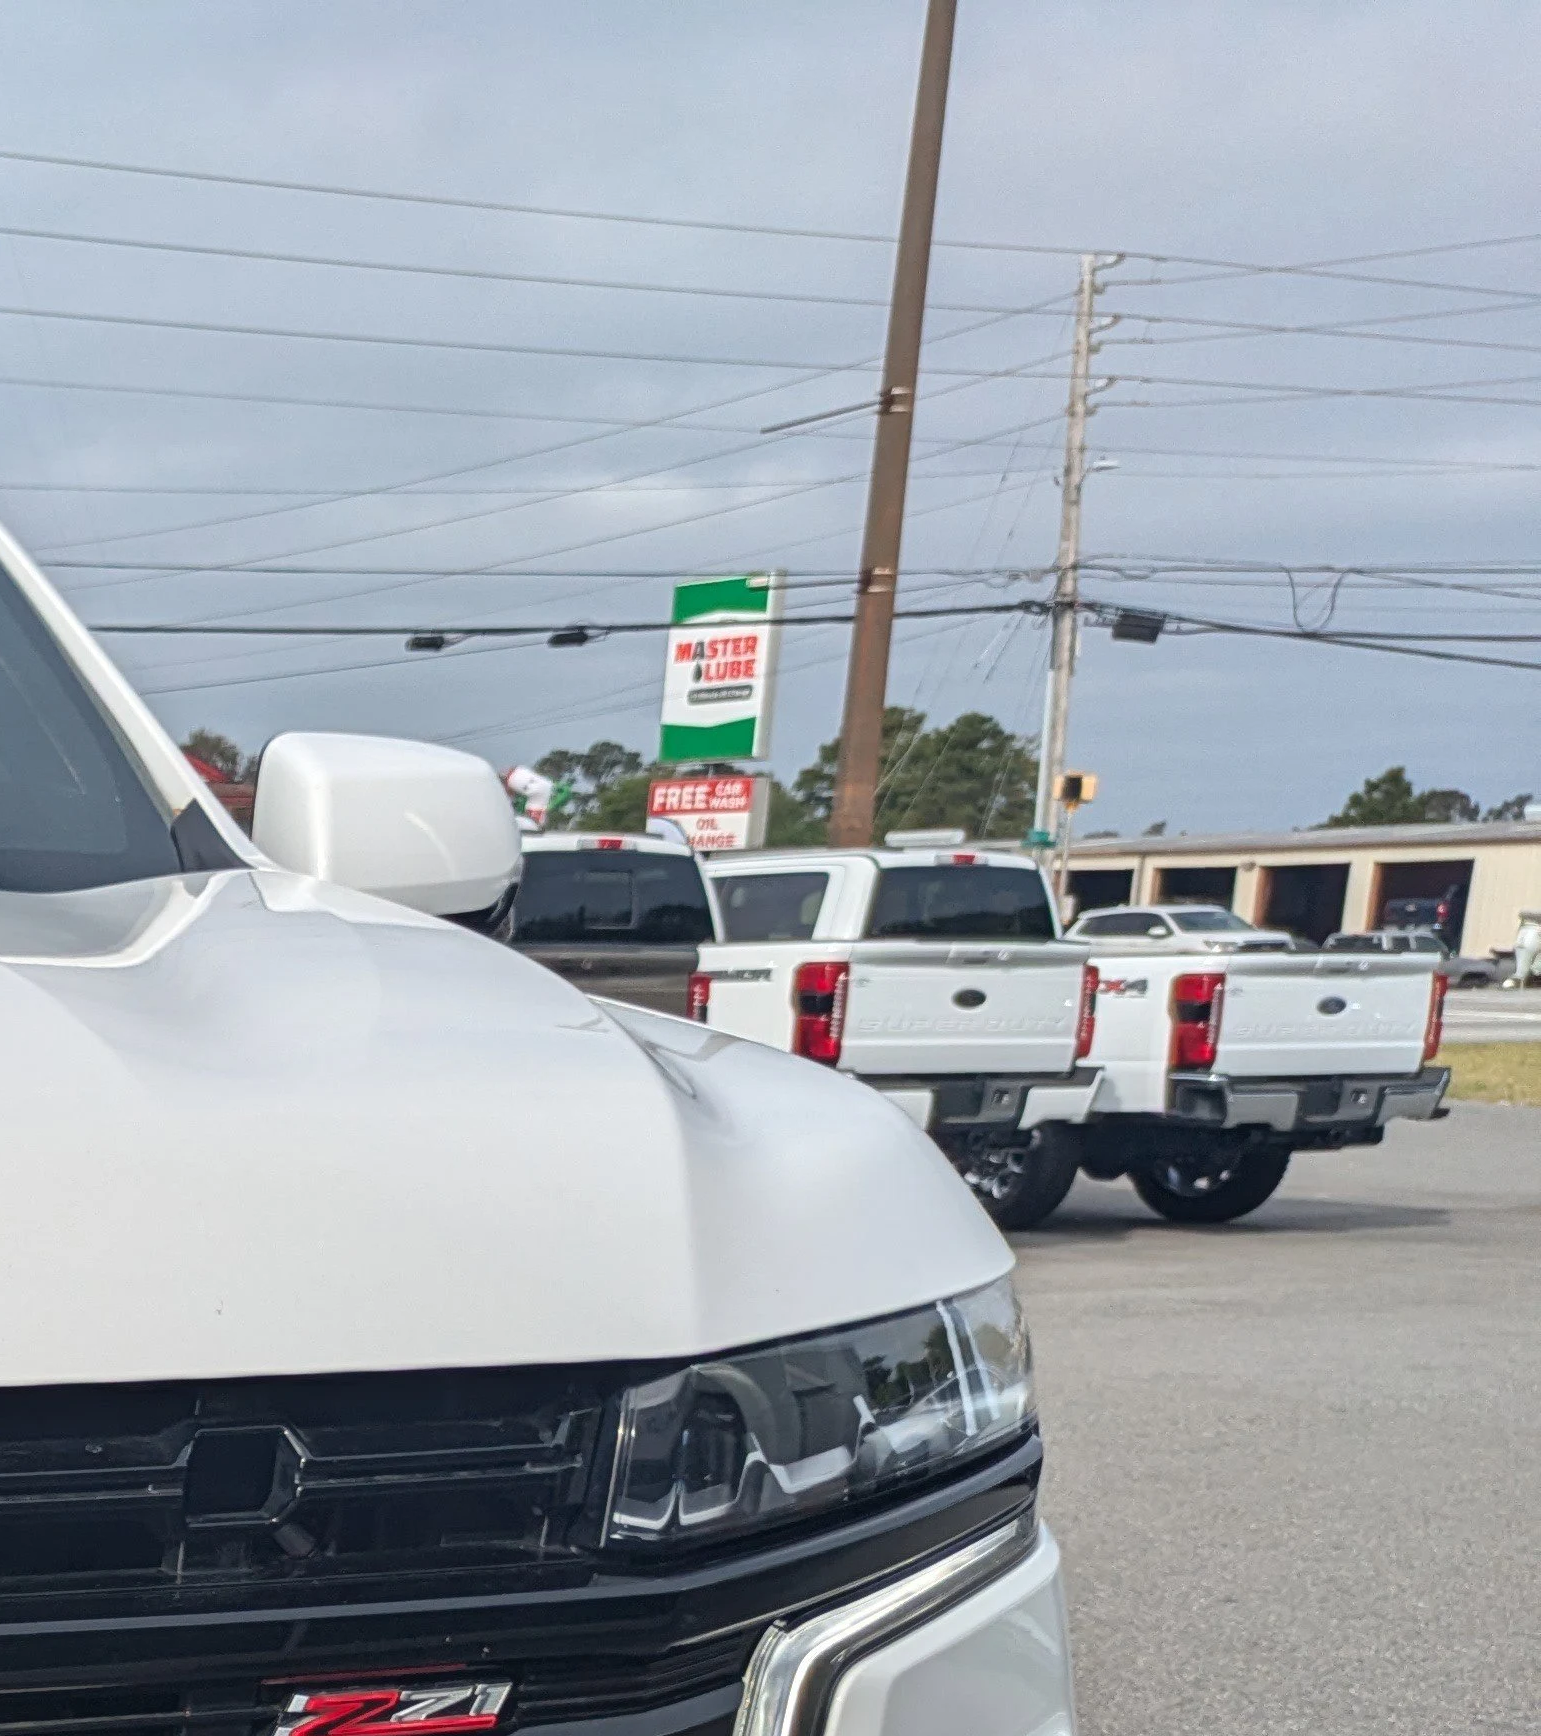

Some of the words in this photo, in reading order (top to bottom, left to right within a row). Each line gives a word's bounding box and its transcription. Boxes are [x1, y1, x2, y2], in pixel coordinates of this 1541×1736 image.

[674, 636, 758, 663] MASTER
[703, 659, 756, 682] LUBE
[652, 783, 711, 811] FREE
[715, 780, 743, 796] CAR
[709, 795, 747, 810] WASH
[696, 818, 718, 830] OIL
